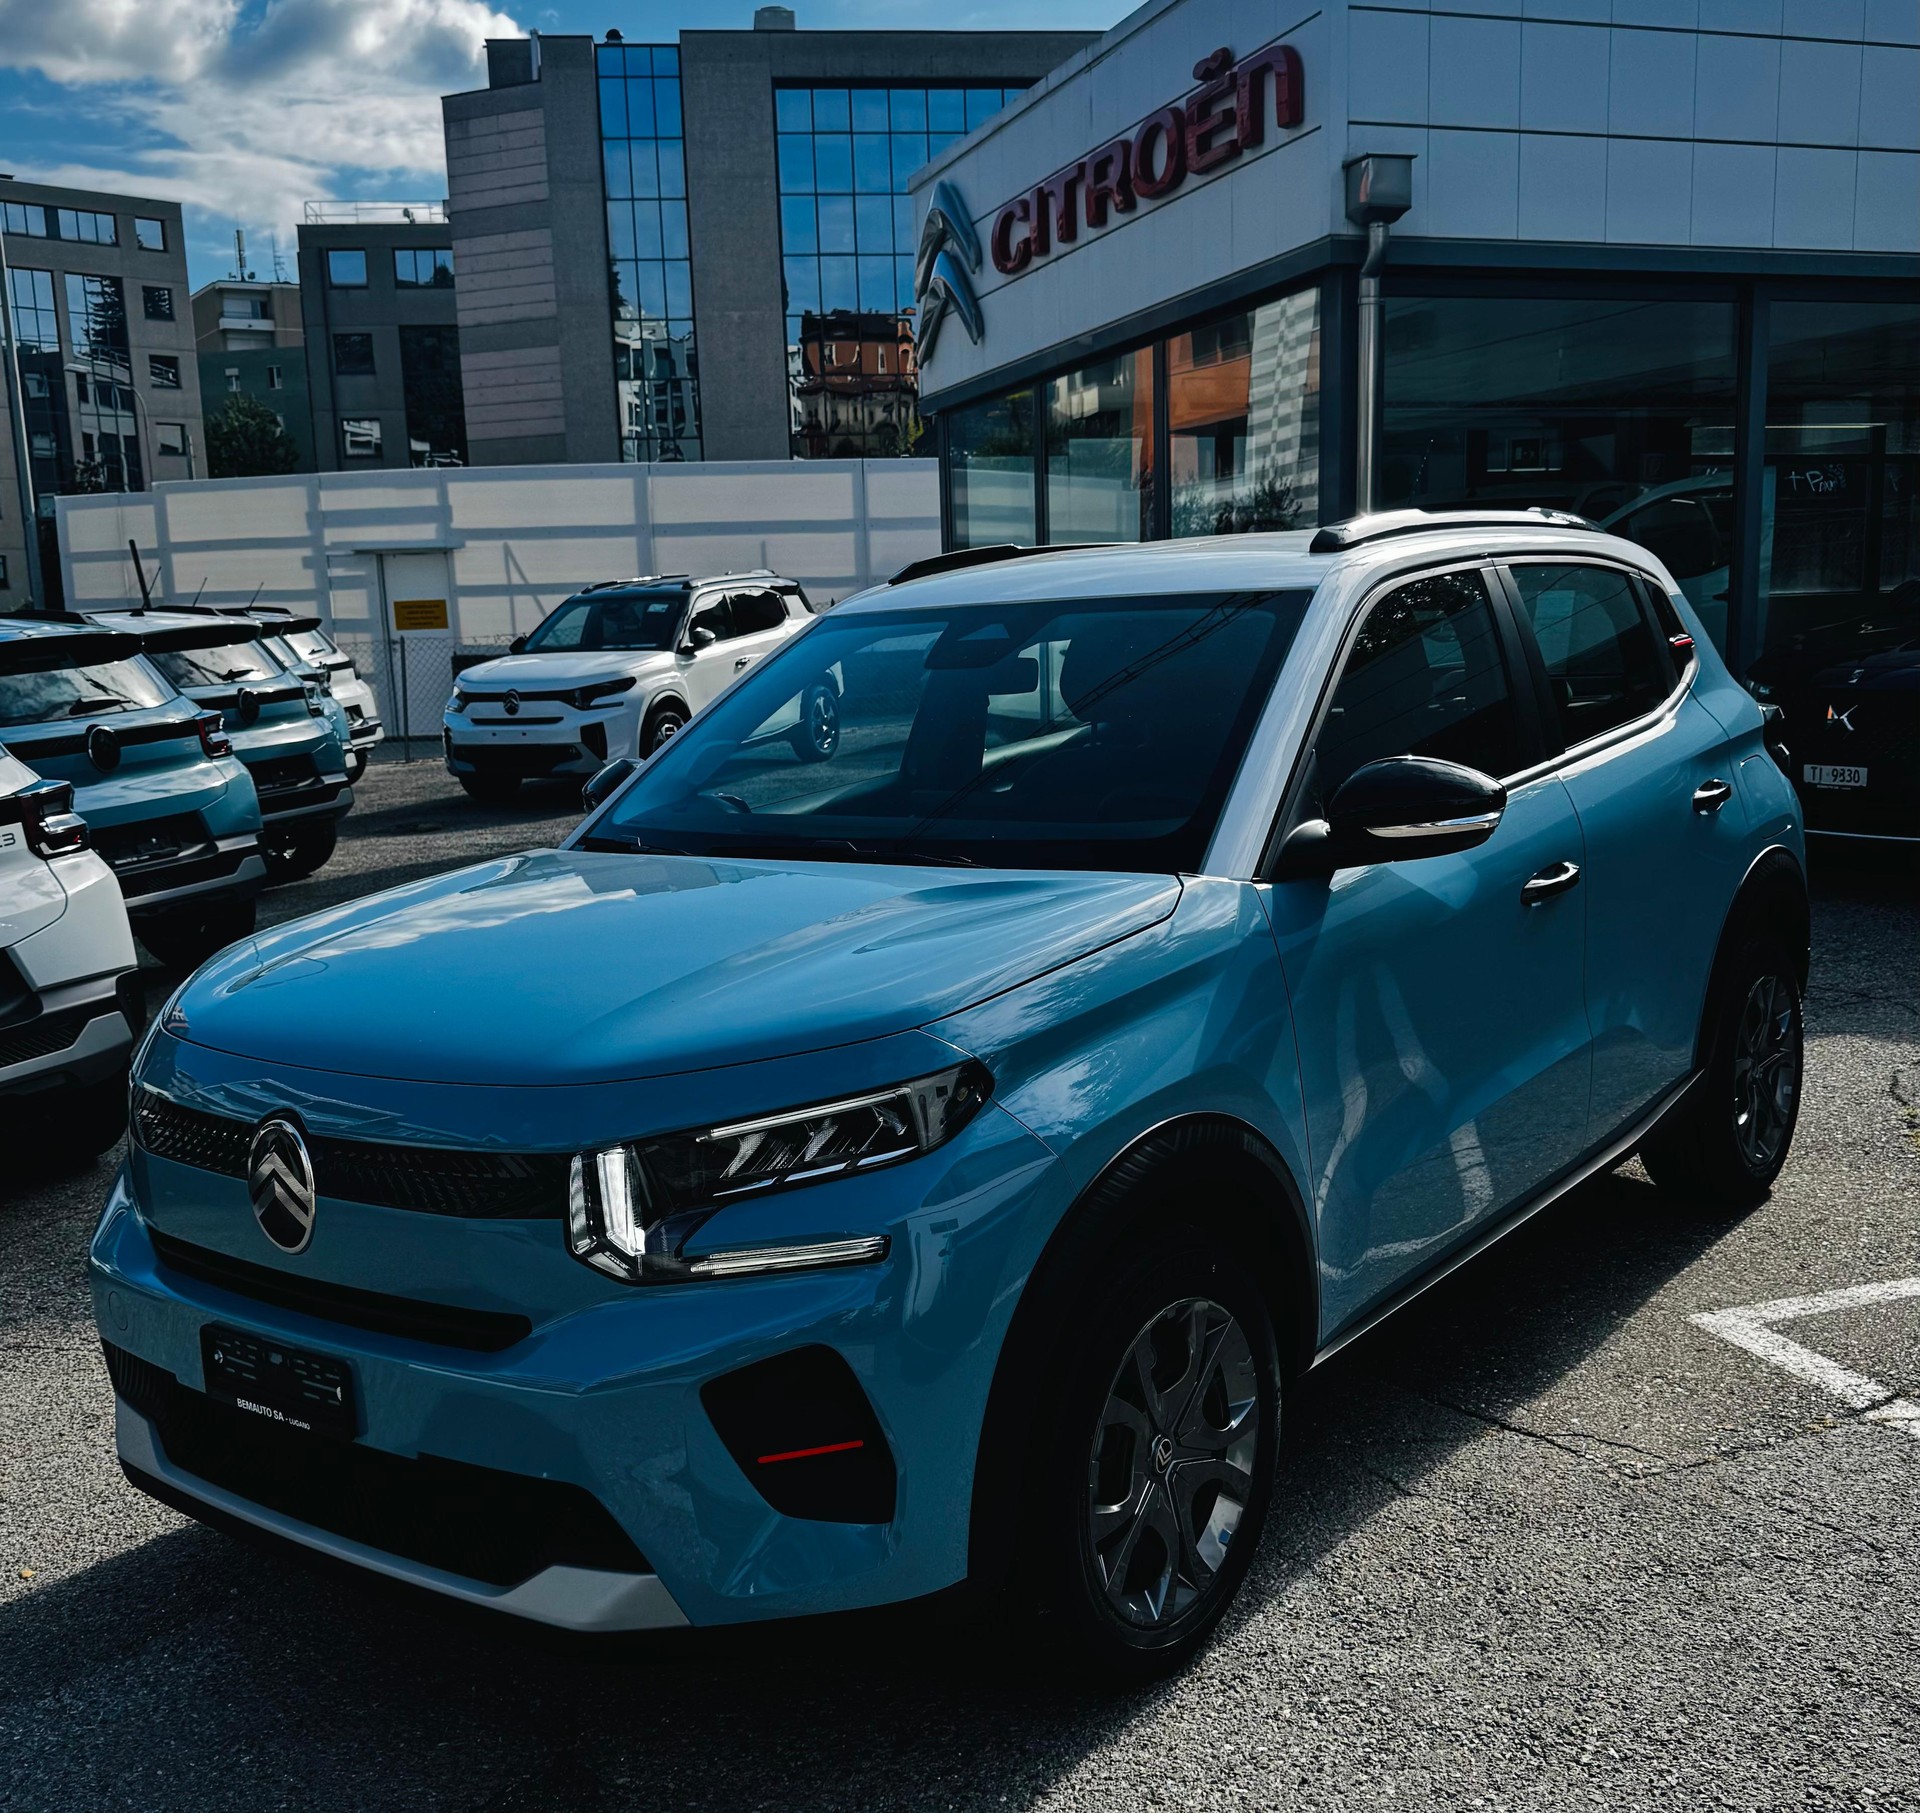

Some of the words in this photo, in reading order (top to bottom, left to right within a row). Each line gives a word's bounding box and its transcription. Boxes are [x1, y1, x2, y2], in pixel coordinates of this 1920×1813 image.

[1811, 767, 1822, 781] TI
[237, 1398, 272, 1417] BEMAUTO
[273, 1410, 285, 1422] SA
[289, 1418, 311, 1430] LUGANO
